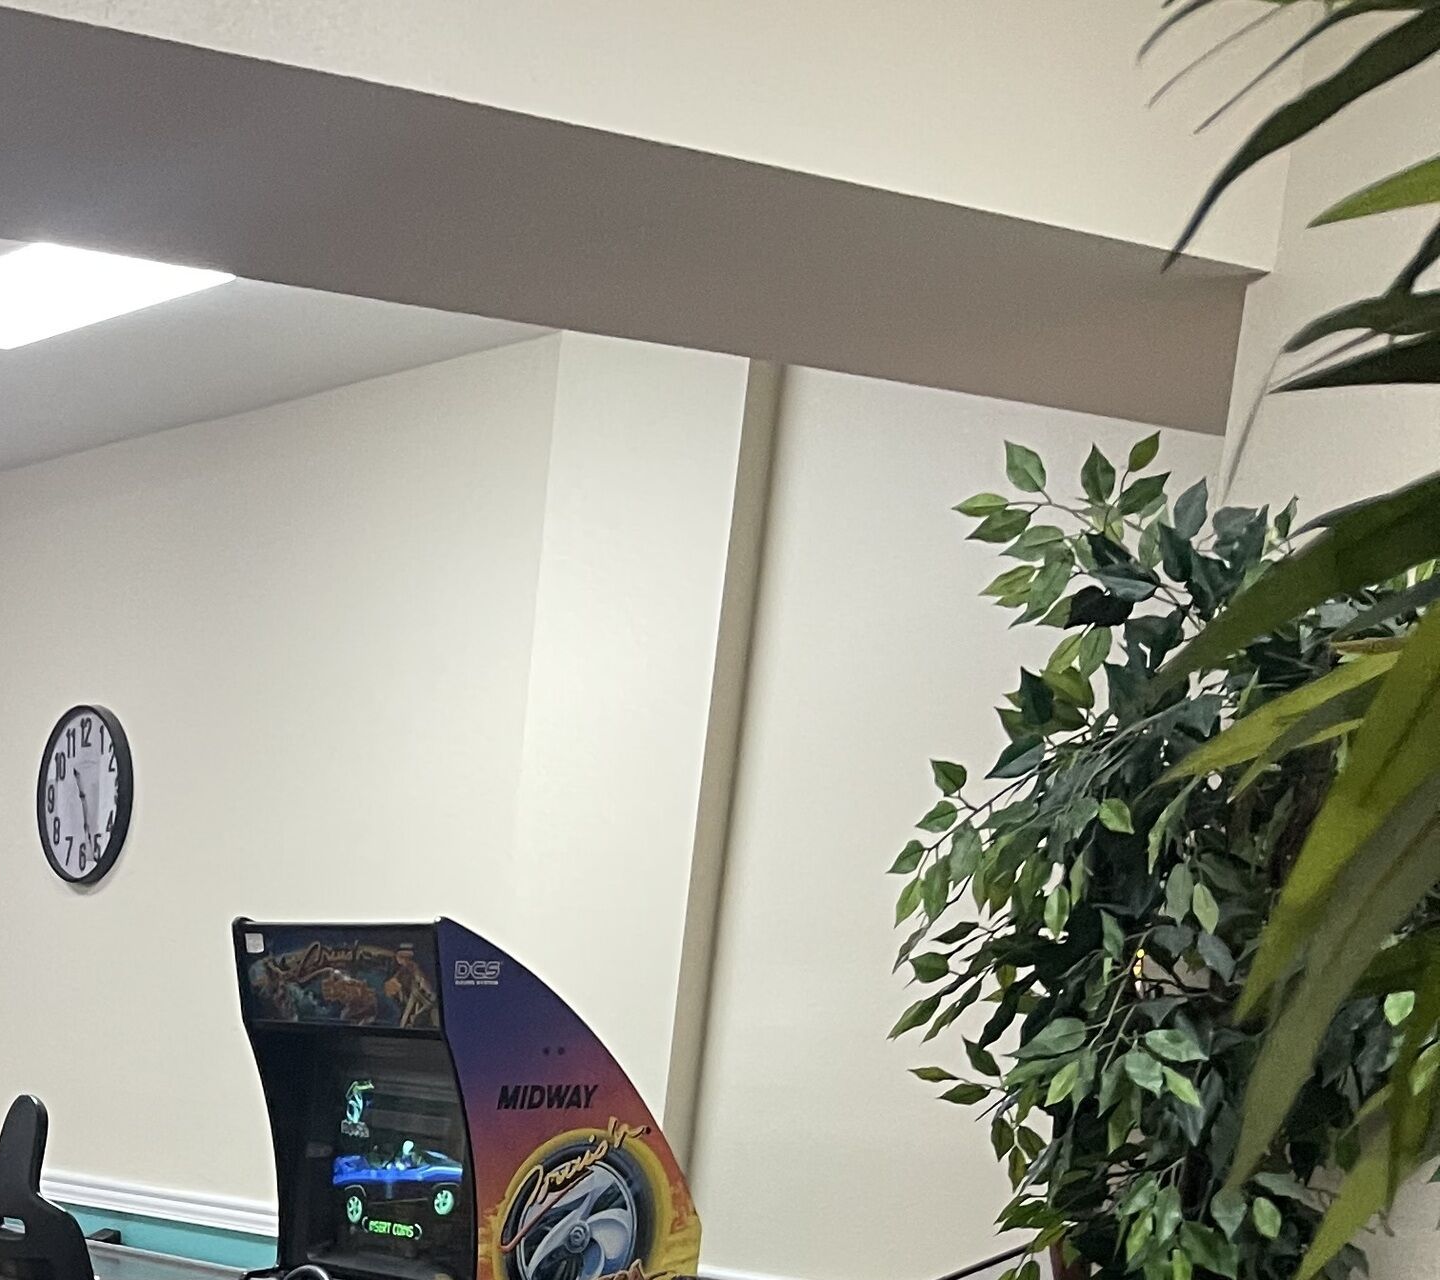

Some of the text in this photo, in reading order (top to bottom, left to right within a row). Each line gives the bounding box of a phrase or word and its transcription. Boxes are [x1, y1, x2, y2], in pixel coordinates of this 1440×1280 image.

[65, 728, 76, 758] 11
[80, 717, 93, 747] 12
[99, 725, 105, 755] 1
[55, 752, 66, 781] 10
[47, 784, 55, 814] 9
[53, 817, 61, 846] 8
[65, 836, 74, 866] 7
[78, 843, 86, 872] 6
[93, 834, 102, 862] 5
[455, 960, 500, 979] DCS
[497, 1084, 598, 1111] MIDWAY
